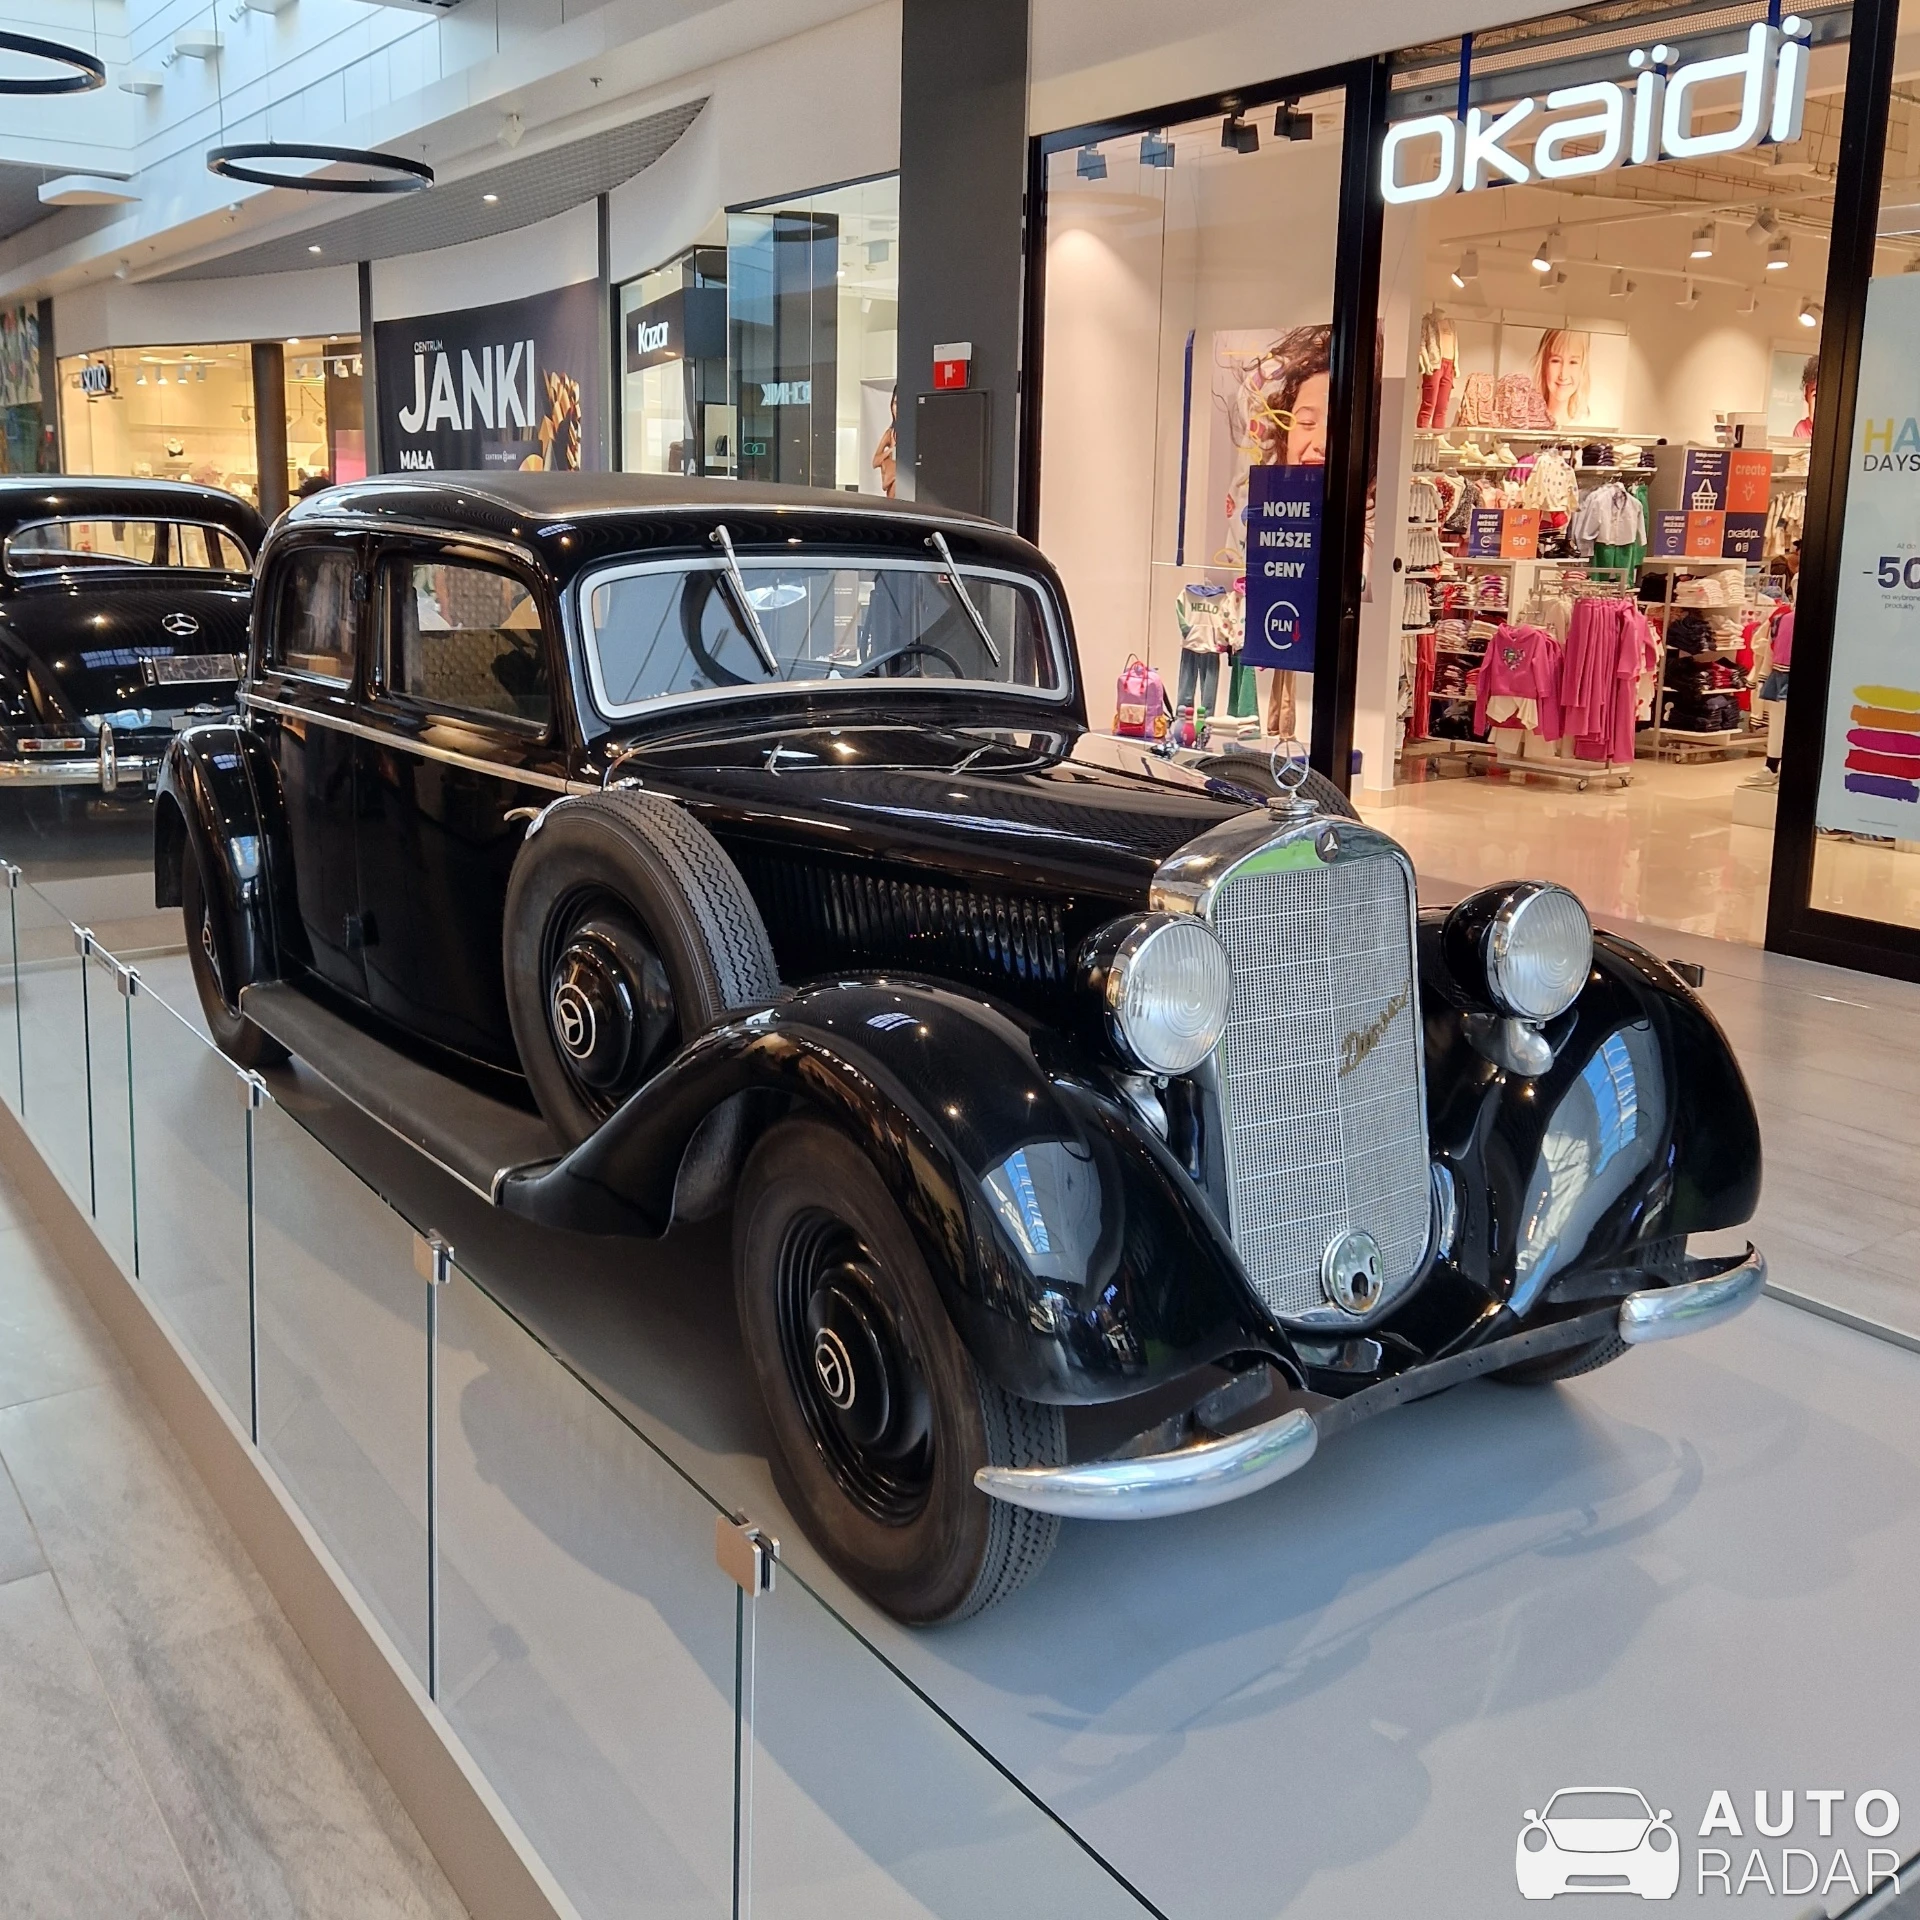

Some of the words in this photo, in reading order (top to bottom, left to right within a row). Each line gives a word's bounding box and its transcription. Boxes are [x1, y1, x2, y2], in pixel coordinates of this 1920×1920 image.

[1380, 15, 1812, 205] okaïdi
[414, 339, 443, 353] CENTRUM
[638, 321, 669, 354] Kazar
[398, 339, 536, 434] JANKI
[400, 450, 434, 470] MAŁA
[1863, 454, 1920, 472] DAYS
[1735, 464, 1767, 475] create
[1263, 501, 1311, 518] NOWE
[1259, 527, 1312, 548] NIŻSZE
[1264, 561, 1305, 578] CENY
[1191, 603, 1219, 615] HELLO
[1271, 619, 1292, 632] PLN
